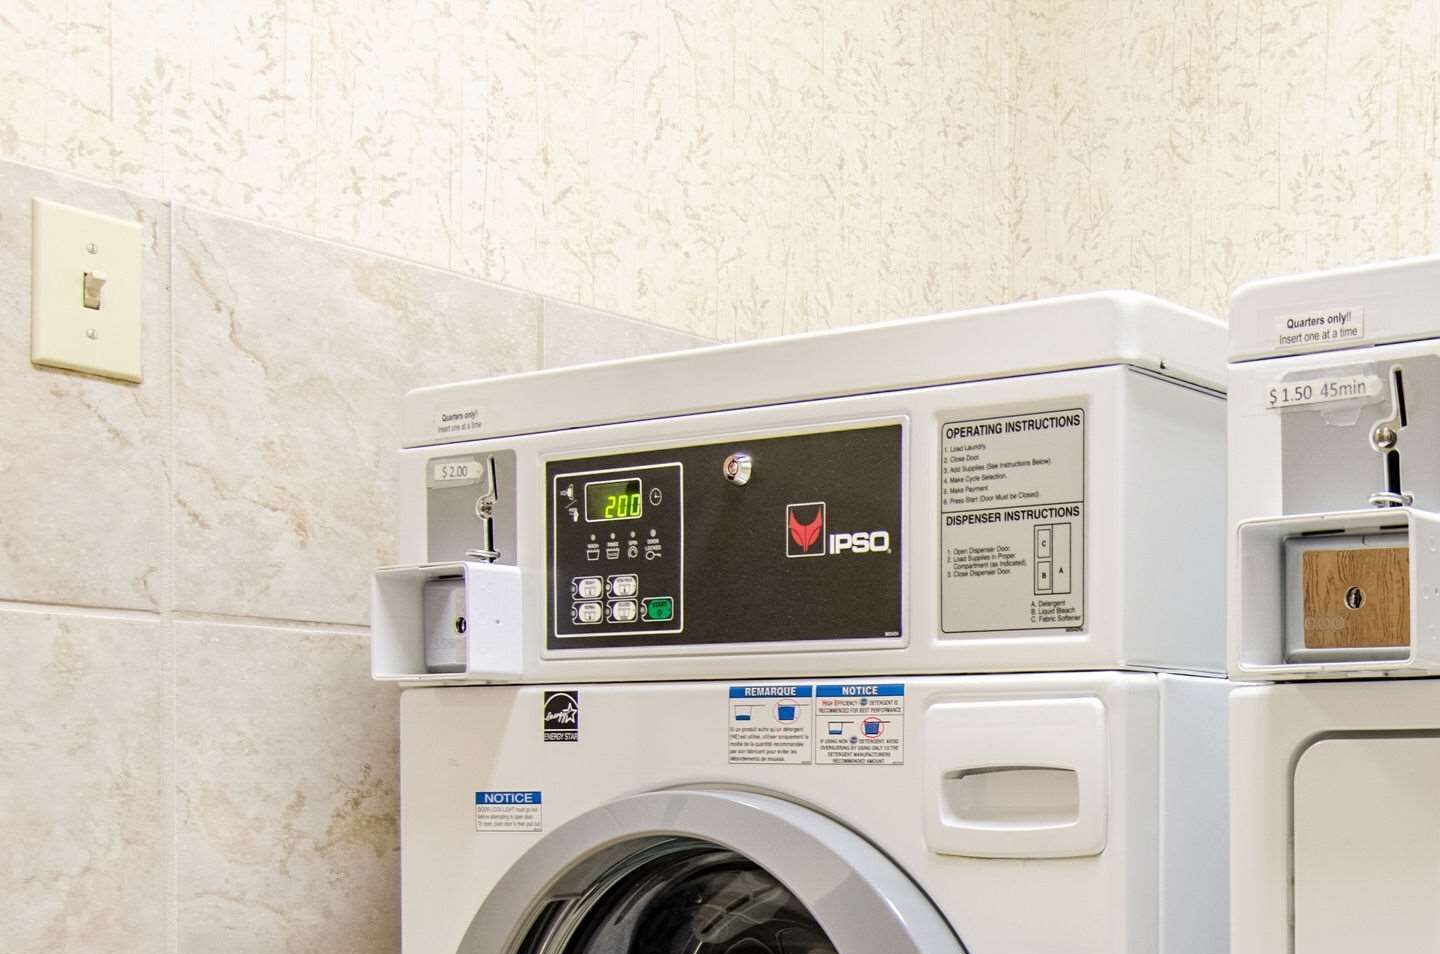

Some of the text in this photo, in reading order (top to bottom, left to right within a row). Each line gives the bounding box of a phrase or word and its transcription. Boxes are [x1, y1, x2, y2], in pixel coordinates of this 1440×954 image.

[1286, 312, 1352, 329] Quarters only!!
[1304, 332, 1320, 342] one
[1322, 331, 1330, 339] at
[1340, 327, 1358, 337] time
[1270, 380, 1366, 406] $ 1.50 45min
[946, 414, 1080, 439] OPERATING INSTRUCTIONS
[962, 465, 985, 473] Supplies
[987, 462, 998, 470] (See
[1000, 460, 1031, 468] Instructions
[442, 466, 468, 478] $ 2.00
[965, 475, 980, 483] Cycle
[980, 494, 994, 502] (Door
[604, 494, 640, 518] 200
[946, 506, 1080, 526] DISPENSER INSTRUCTIONS
[830, 531, 889, 555] IPSO
[953, 548, 968, 556] Open
[969, 546, 995, 555] Dispenser
[968, 554, 990, 562] Supplies
[998, 553, 1016, 561] Proper
[953, 562, 989, 570] Compartment
[990, 561, 998, 569] (as
[970, 569, 996, 577] Dispenser
[1038, 600, 1066, 608] Detergent
[1056, 606, 1076, 614] Bleach
[1057, 614, 1081, 622] Softener
[744, 686, 797, 696] REMARQUE
[842, 686, 878, 695] NOTICE
[565, 732, 578, 740] STAR
[484, 793, 533, 804] NOTICE
